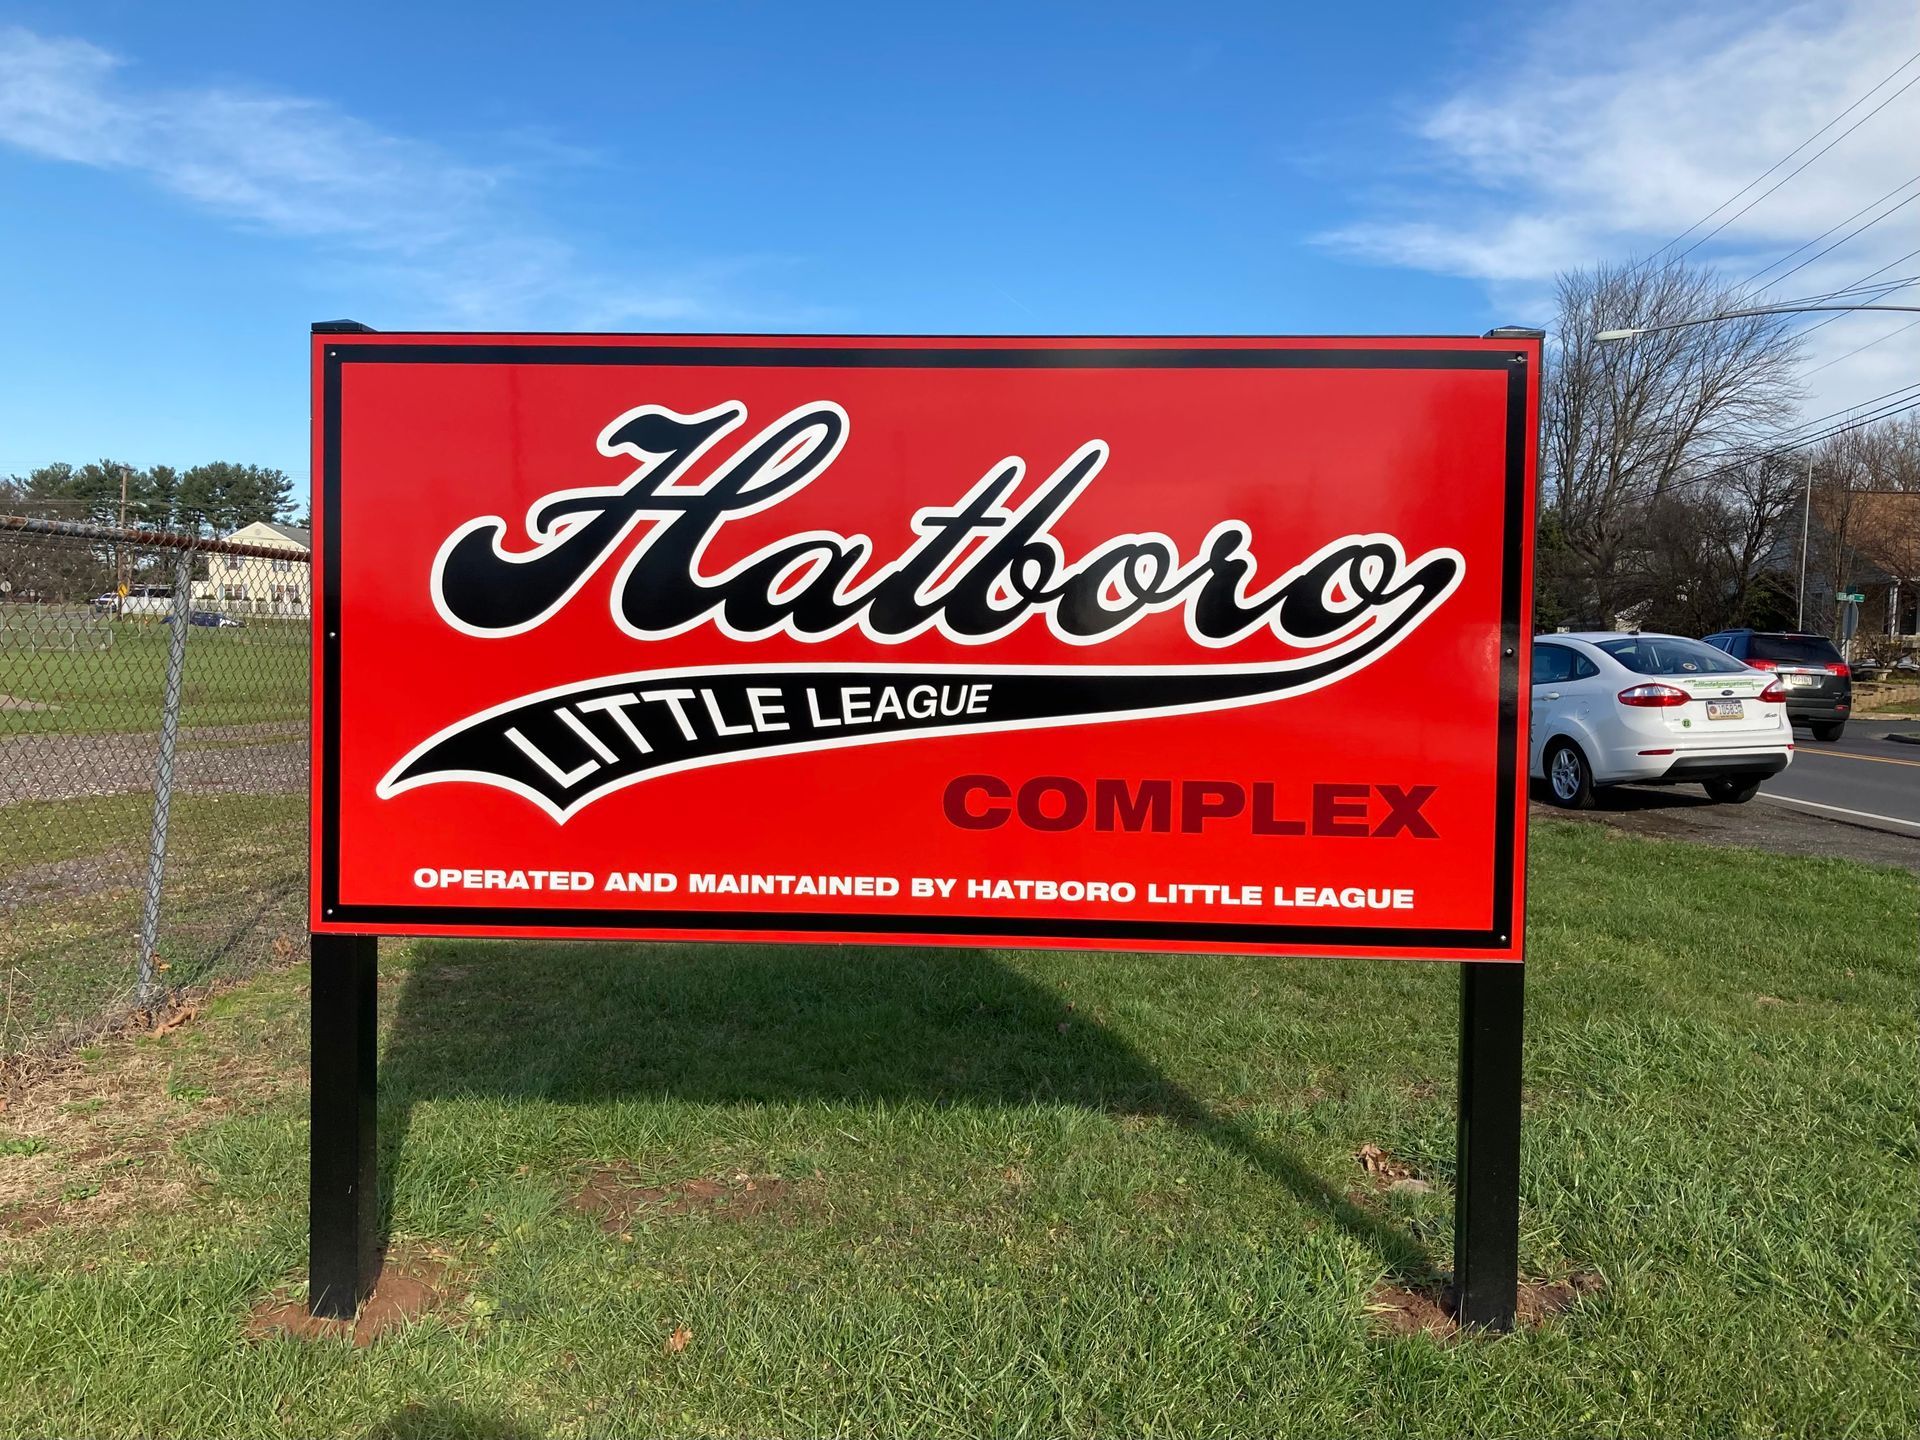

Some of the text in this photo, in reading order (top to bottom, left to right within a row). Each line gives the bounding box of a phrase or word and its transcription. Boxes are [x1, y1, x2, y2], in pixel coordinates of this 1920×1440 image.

[431, 399, 1465, 644] Hatboro
[504, 684, 993, 788] LITTLE LEAGUE
[942, 774, 1440, 839] COMPLEX
[413, 868, 1414, 909] OPERATED AND MAINTAINED BY HATBORO LITTLE LEAGUE
